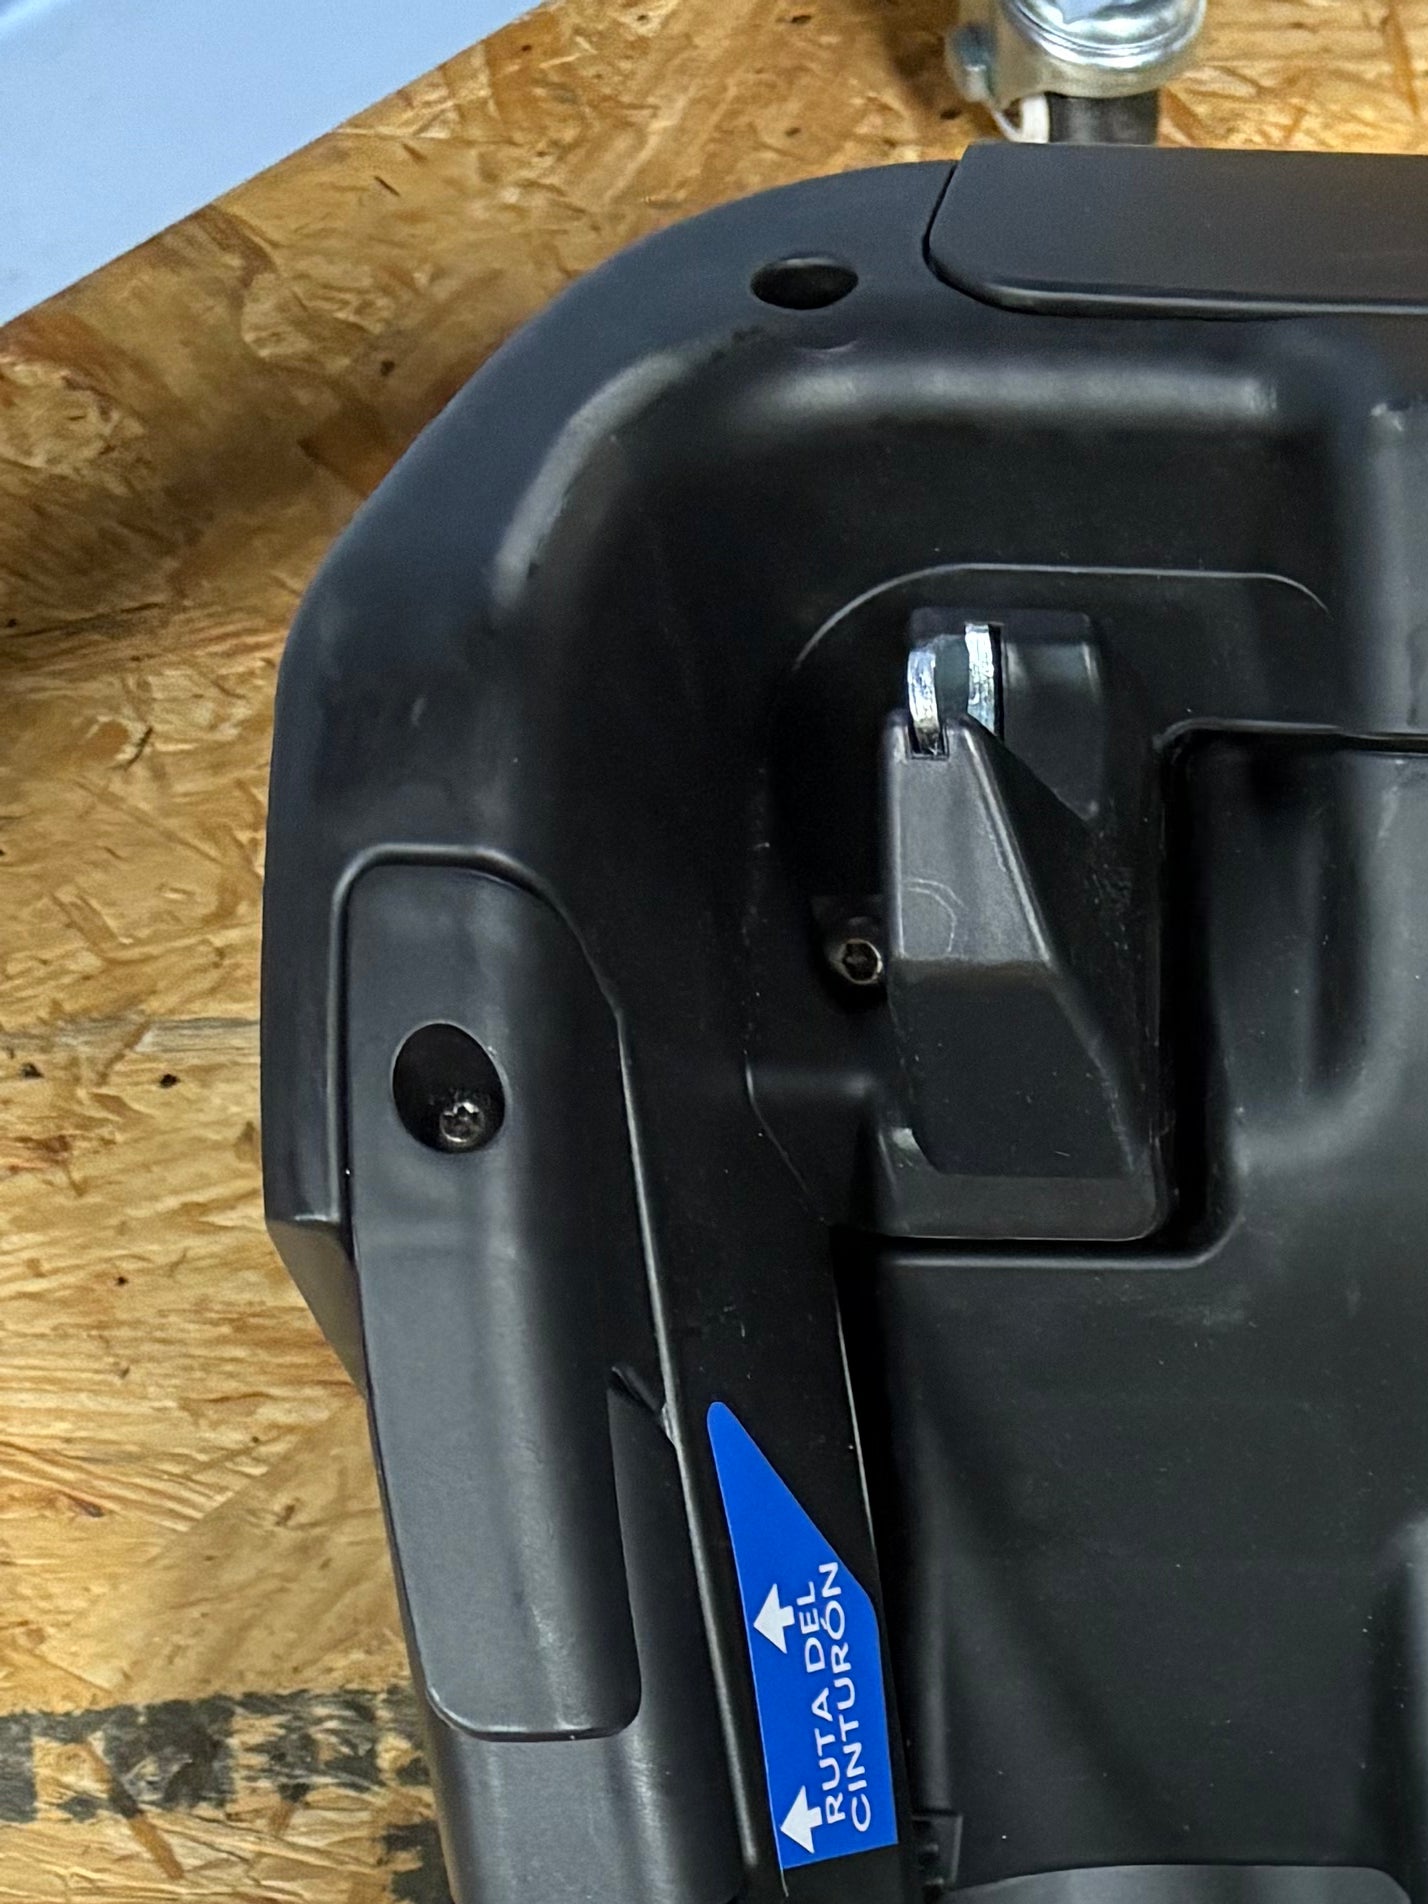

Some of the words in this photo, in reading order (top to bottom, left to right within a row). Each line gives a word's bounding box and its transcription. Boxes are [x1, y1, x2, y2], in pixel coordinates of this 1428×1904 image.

[796, 1581, 825, 1672] DEL
[810, 1686, 846, 1824] RUTA
[819, 1562, 872, 1832] CINTURÓN
